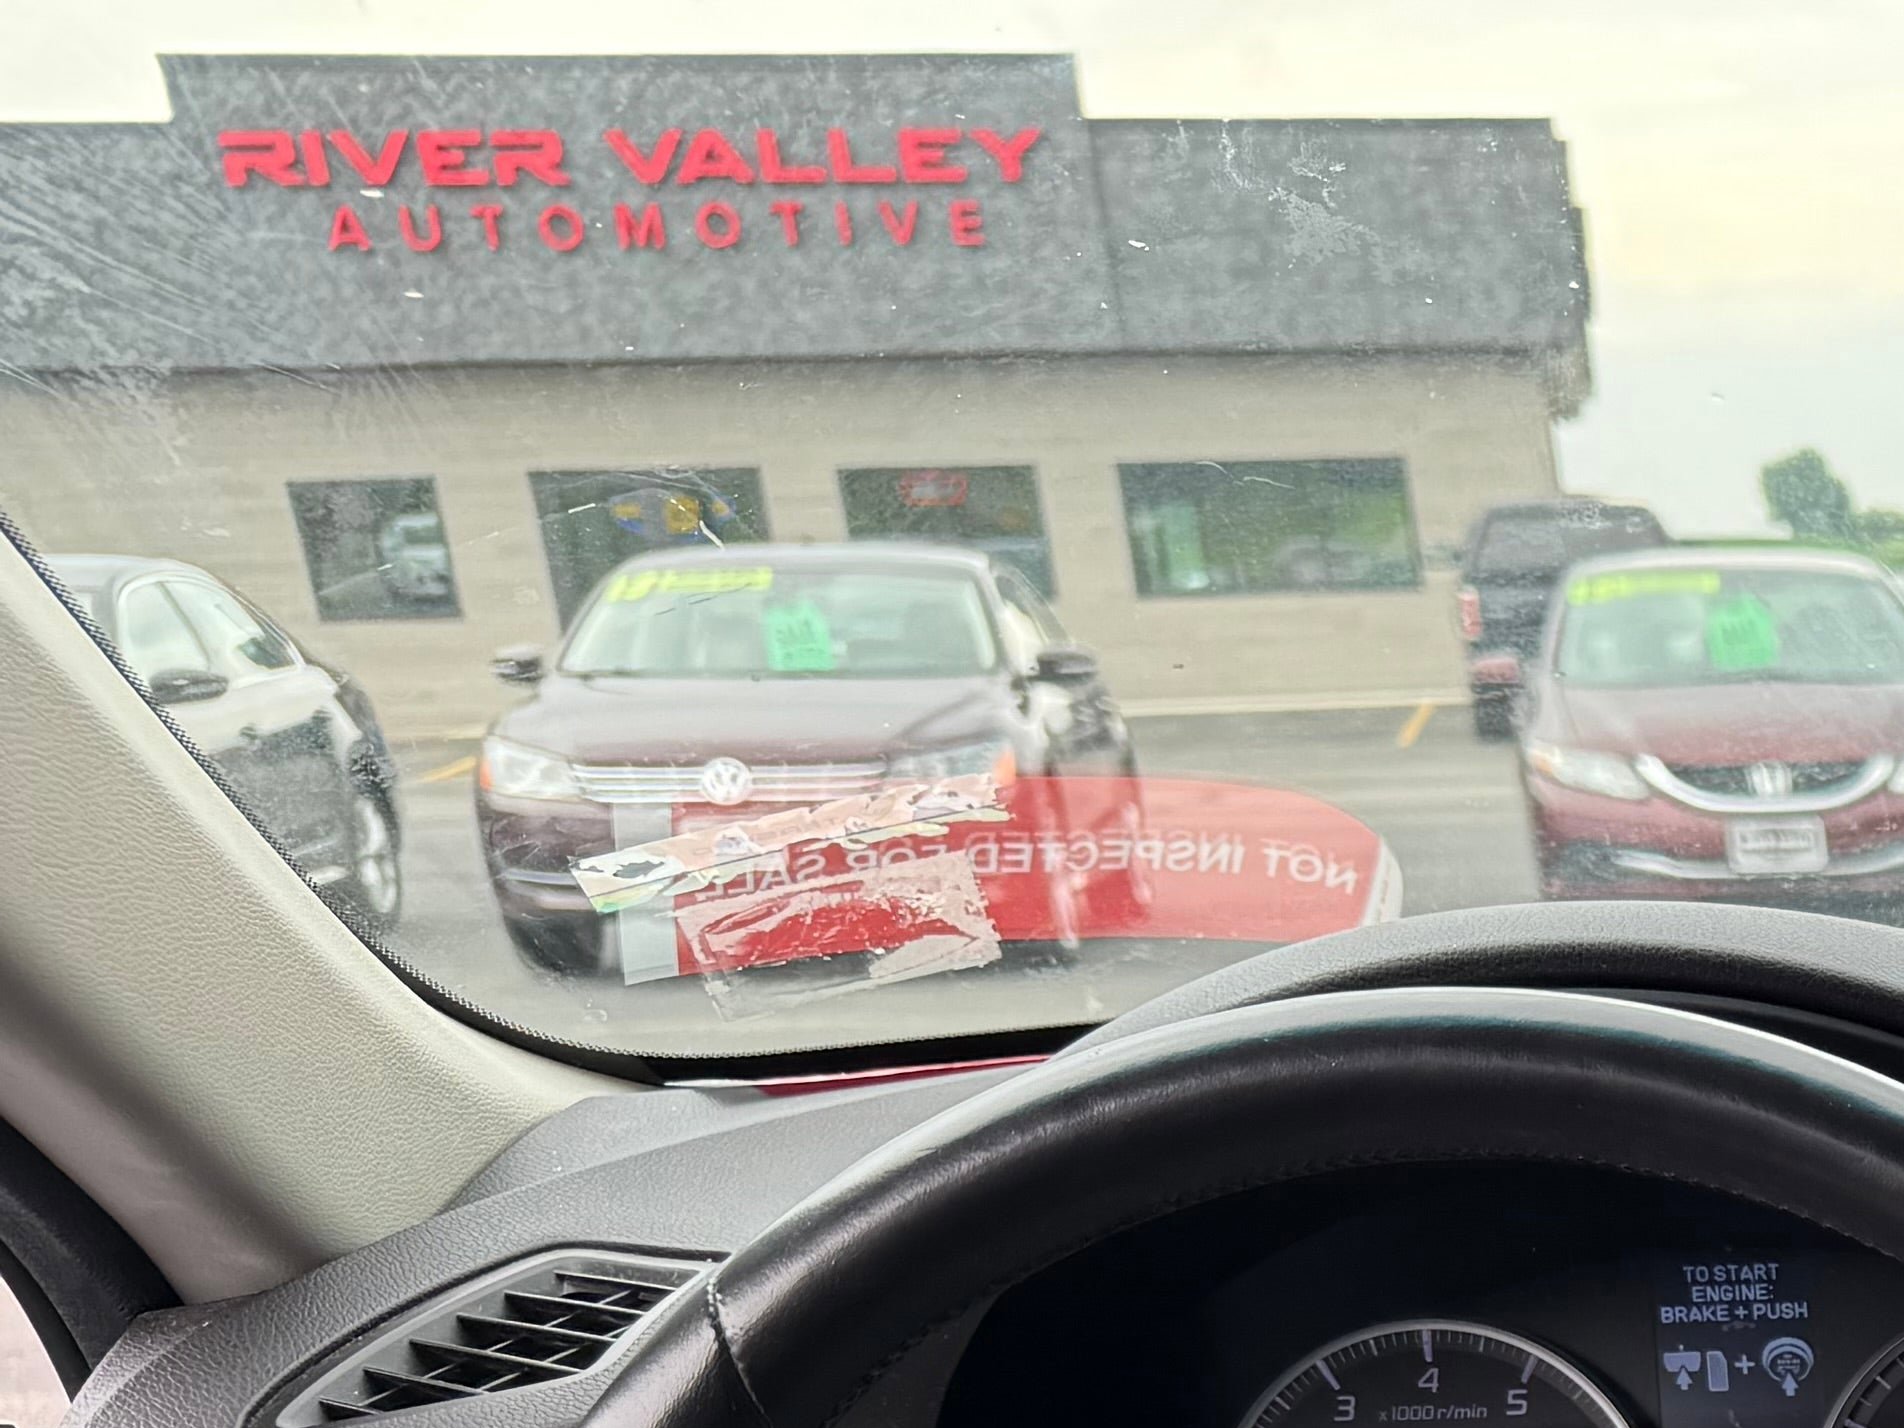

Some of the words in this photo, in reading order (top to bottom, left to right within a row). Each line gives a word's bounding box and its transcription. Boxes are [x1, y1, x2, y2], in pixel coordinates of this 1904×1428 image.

[215, 128, 573, 188] RIVER
[603, 125, 1044, 185] VALLEY
[328, 198, 988, 252] AUTOMOTIVE
[1683, 1266, 1709, 1283] TO
[1713, 1263, 1779, 1282] START
[1691, 1283, 1774, 1302] ENGINE:
[1660, 1304, 1731, 1324] BRAKE
[1753, 1301, 1809, 1321] PUSH
[1417, 1368, 1441, 1394] 4
[1332, 1395, 1356, 1422] 3
[1437, 1403, 1488, 1420] r/min
[1506, 1389, 1529, 1416] 5
